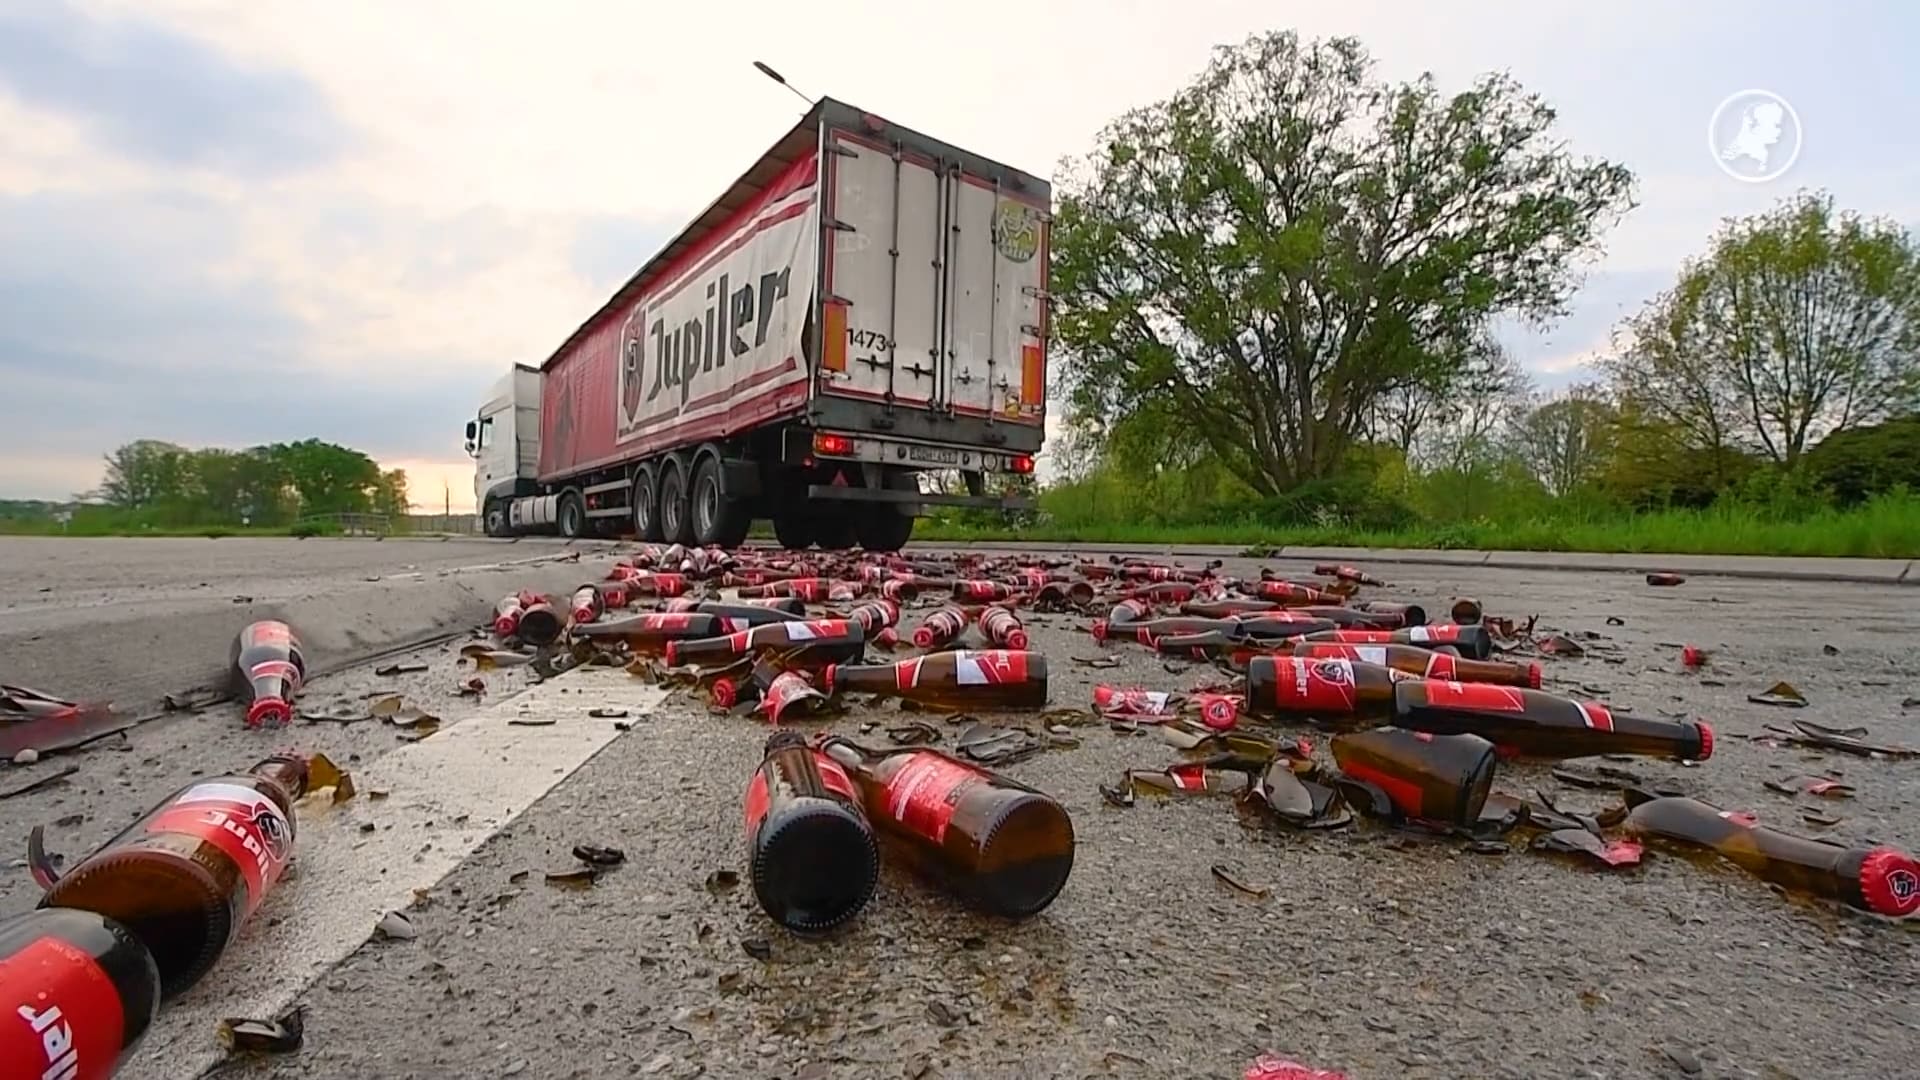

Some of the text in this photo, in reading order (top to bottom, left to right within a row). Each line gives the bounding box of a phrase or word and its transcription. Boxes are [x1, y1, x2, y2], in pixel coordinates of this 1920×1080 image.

[647, 265, 791, 406] Jupiler
[846, 327, 886, 352] 1473
[199, 810, 270, 890] Jupil
